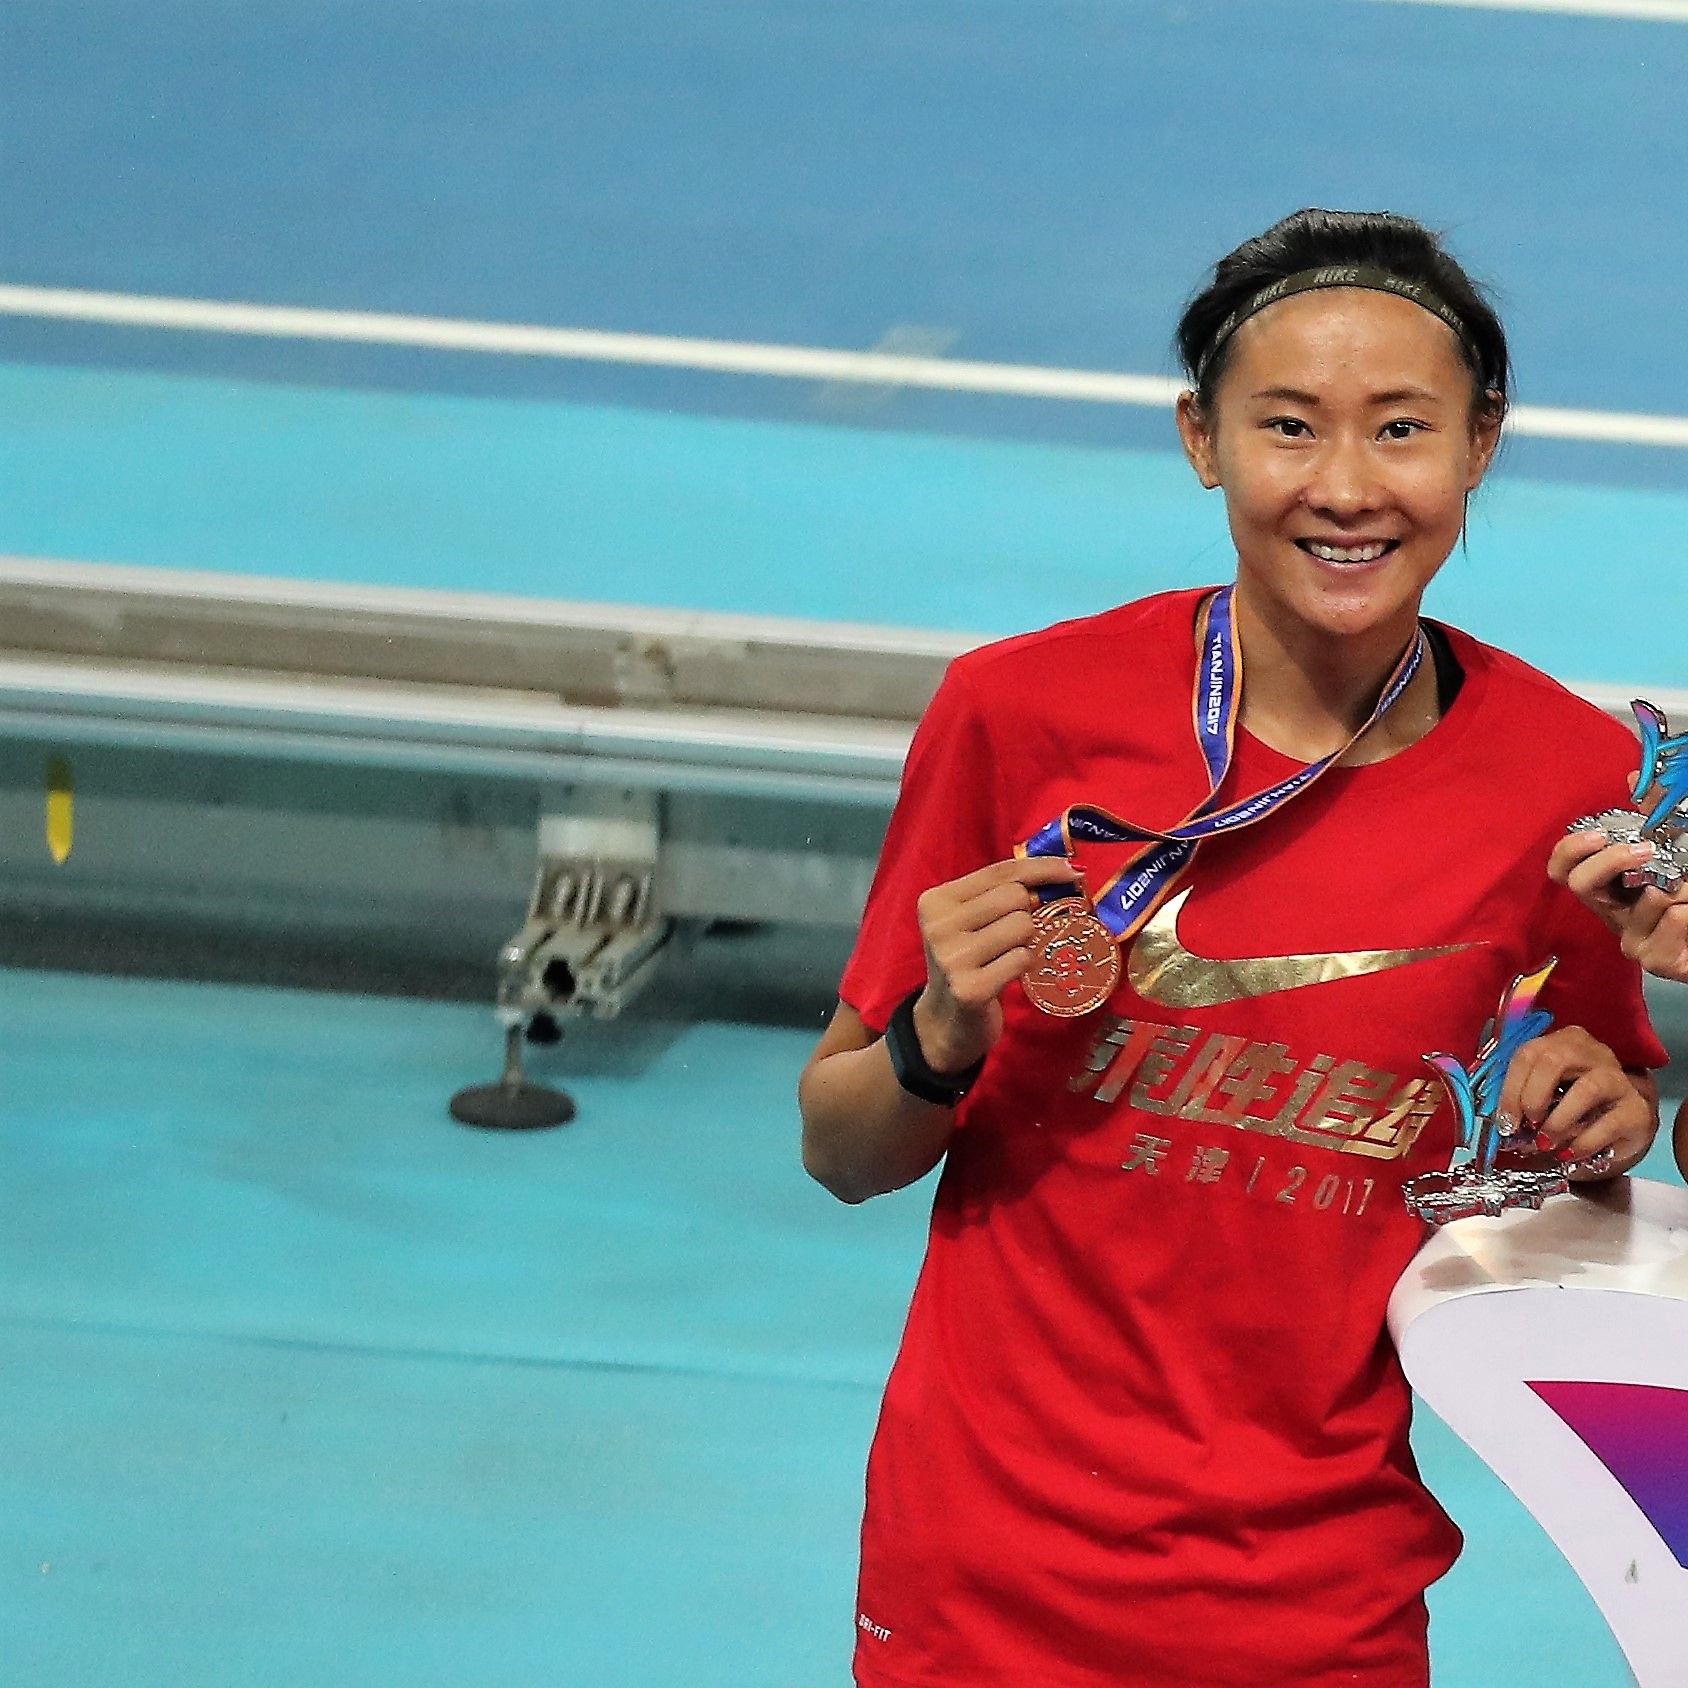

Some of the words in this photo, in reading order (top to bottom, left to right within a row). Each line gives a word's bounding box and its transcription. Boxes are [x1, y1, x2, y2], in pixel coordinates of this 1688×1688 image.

[1313, 269, 1359, 284] NIKE
[1206, 632, 1224, 736] TIANJIN2017
[1213, 773, 1313, 829] TIANJIN2017
[1120, 1132, 1230, 1185] 天津
[1276, 1166, 1375, 1217] 2017
